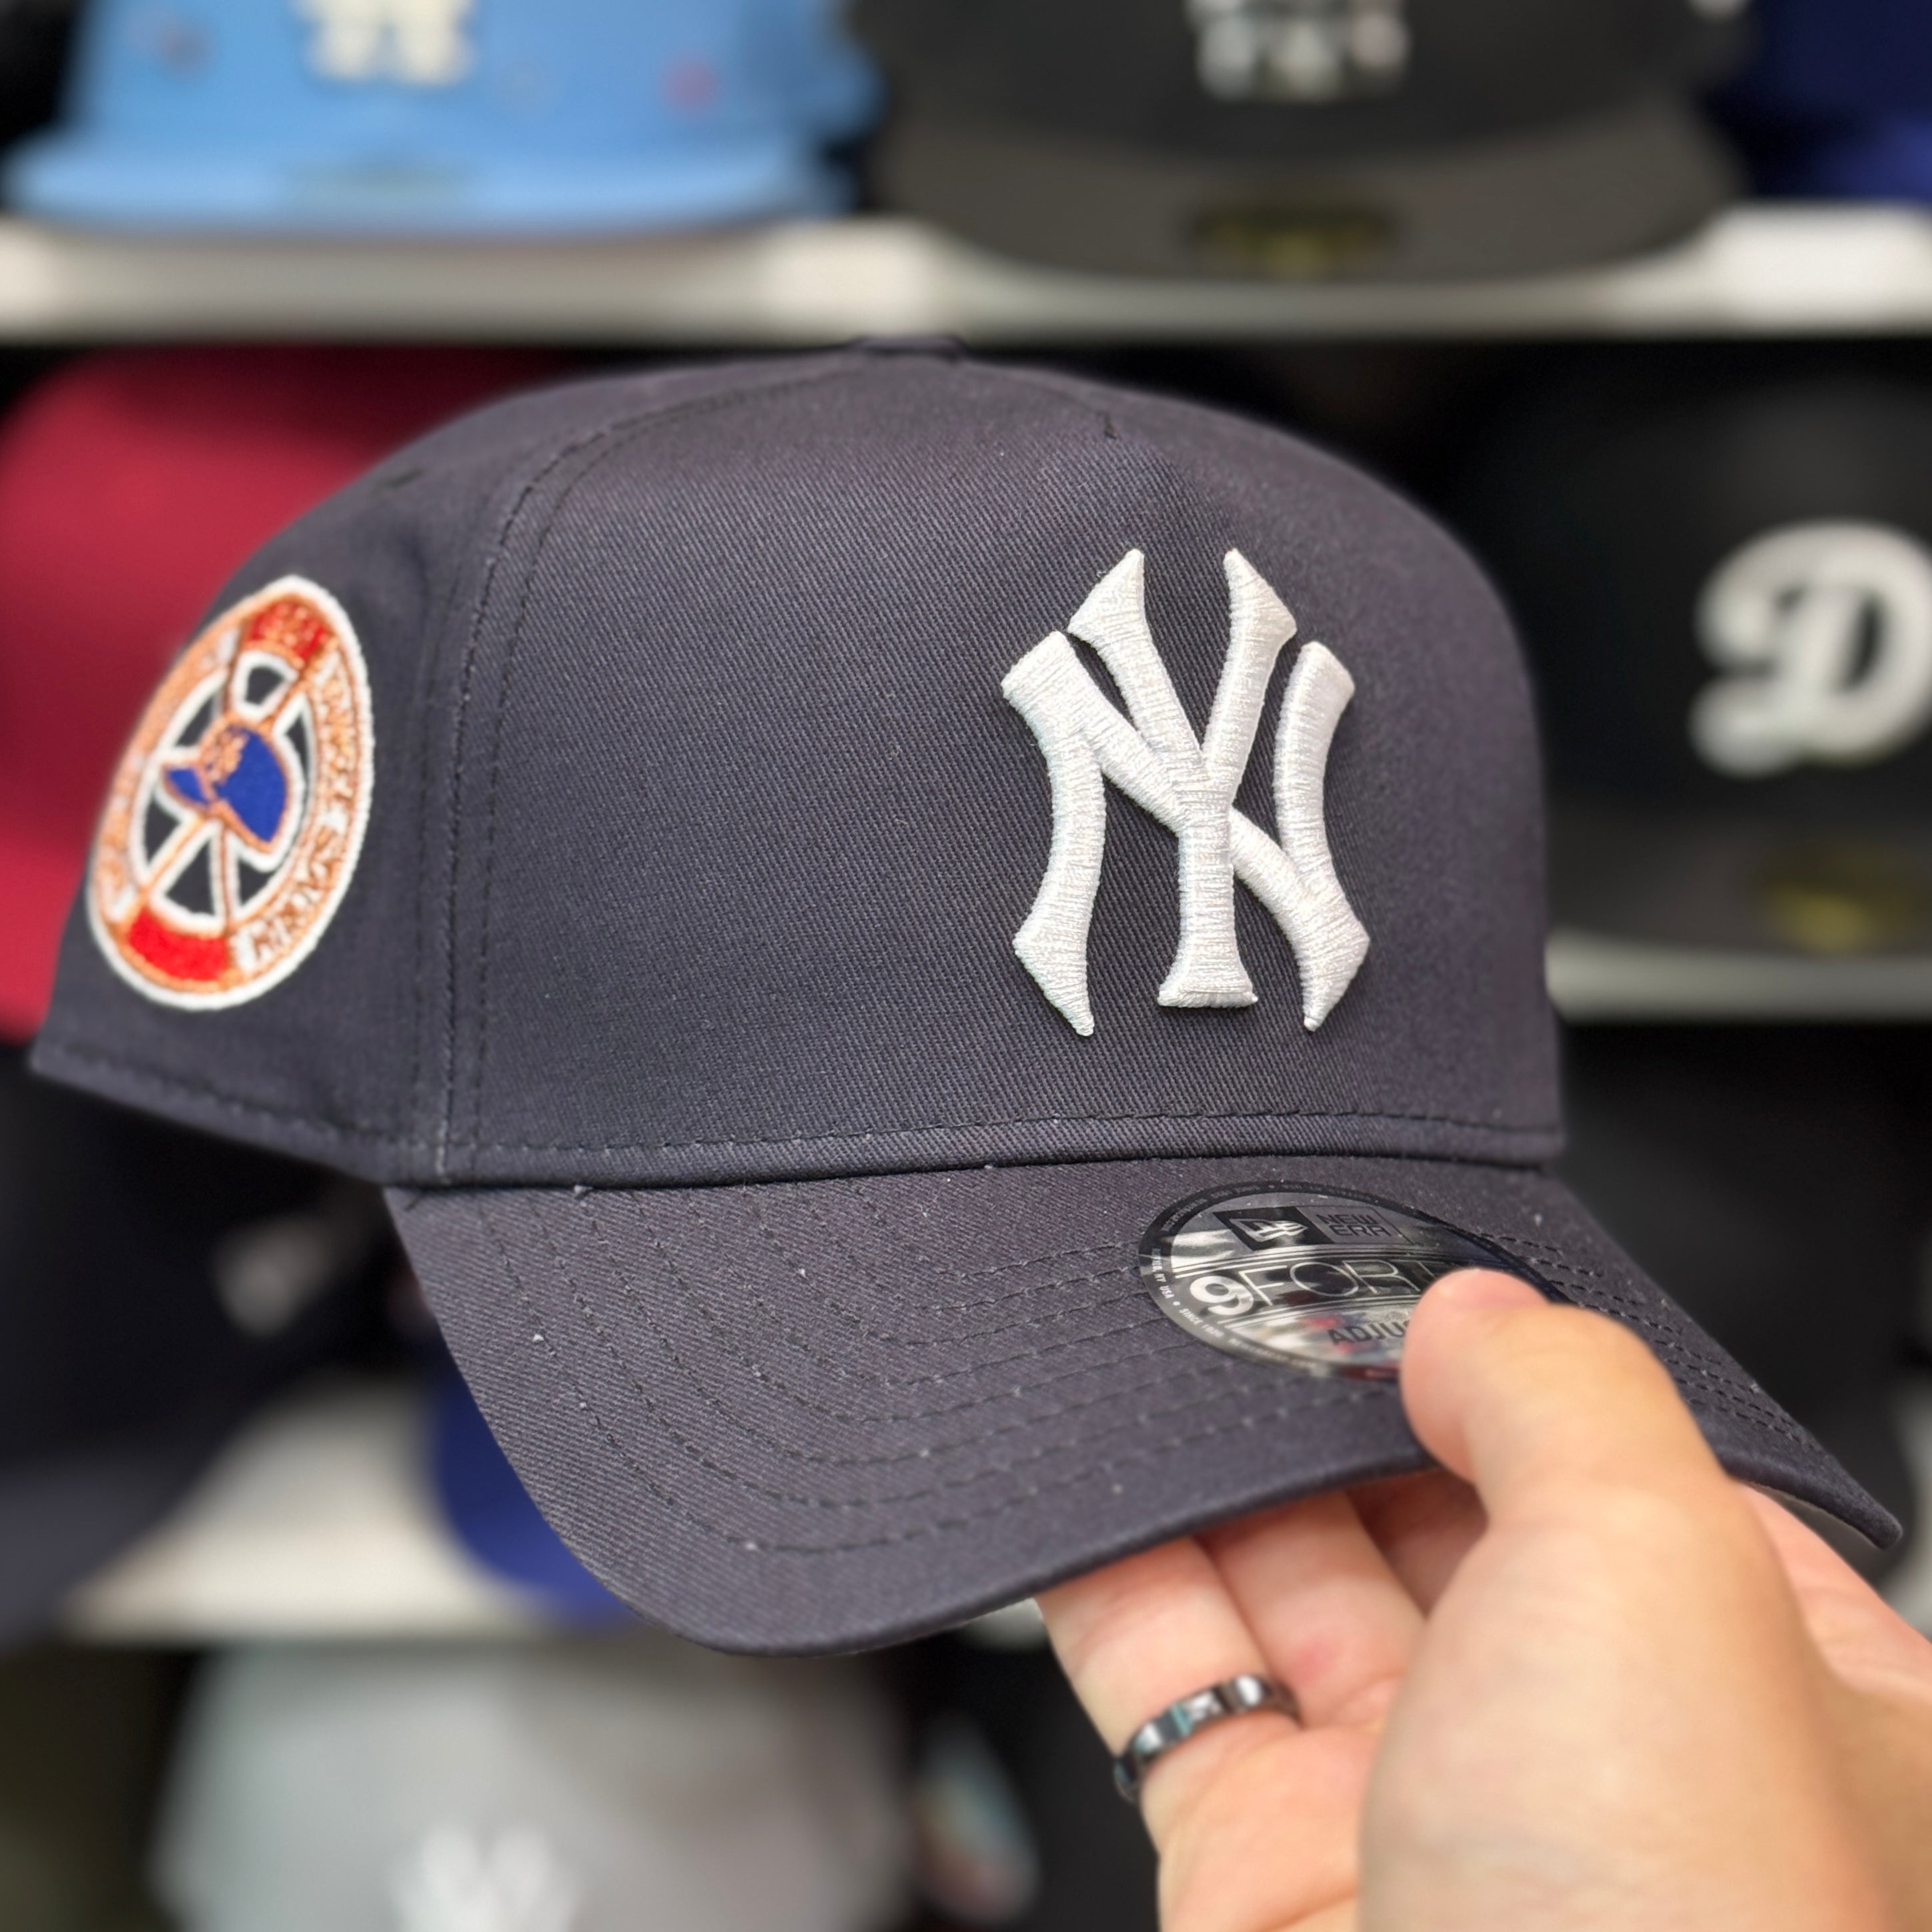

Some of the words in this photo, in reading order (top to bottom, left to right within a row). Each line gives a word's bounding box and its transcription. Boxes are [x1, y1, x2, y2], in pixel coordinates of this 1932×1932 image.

[1001, 548, 1370, 1035] NY
[1316, 1214, 1378, 1226] NEW
[1329, 1225, 1392, 1237] ERA
[1189, 1260, 1445, 1316] 9FORT
